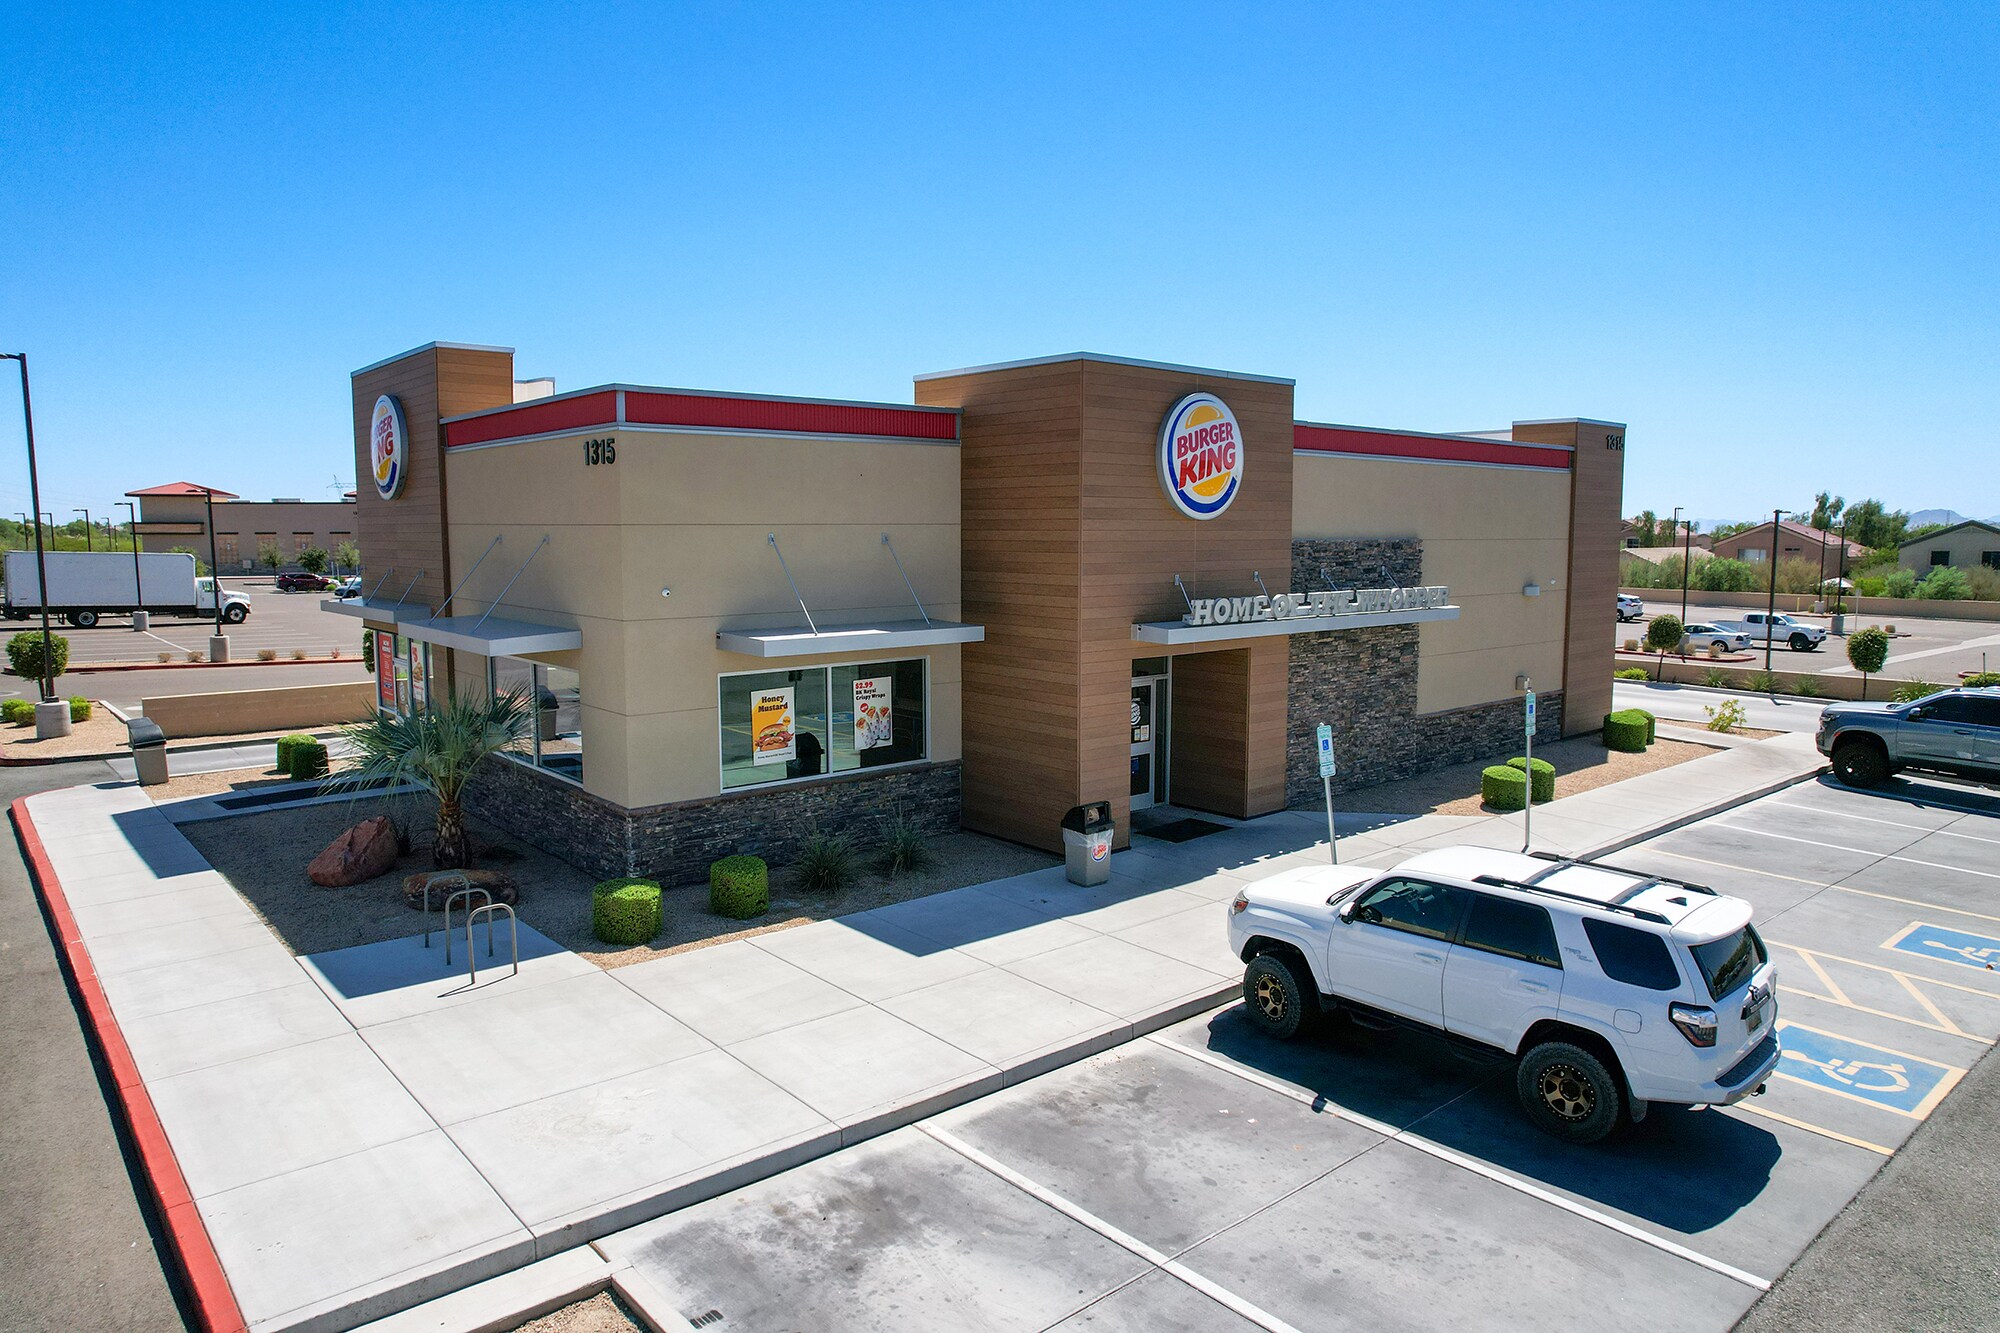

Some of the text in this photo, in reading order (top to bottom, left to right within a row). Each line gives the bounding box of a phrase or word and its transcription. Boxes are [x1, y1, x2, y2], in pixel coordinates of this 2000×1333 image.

[583, 438, 616, 466] 1315
[1177, 422, 1234, 459] BURGER
[1179, 441, 1236, 489] KING
[1192, 586, 1449, 625] HOME OF THE WHOPPER
[761, 694, 785, 703] Honey
[855, 681, 873, 689] $2.99
[758, 702, 788, 713] Mustard
